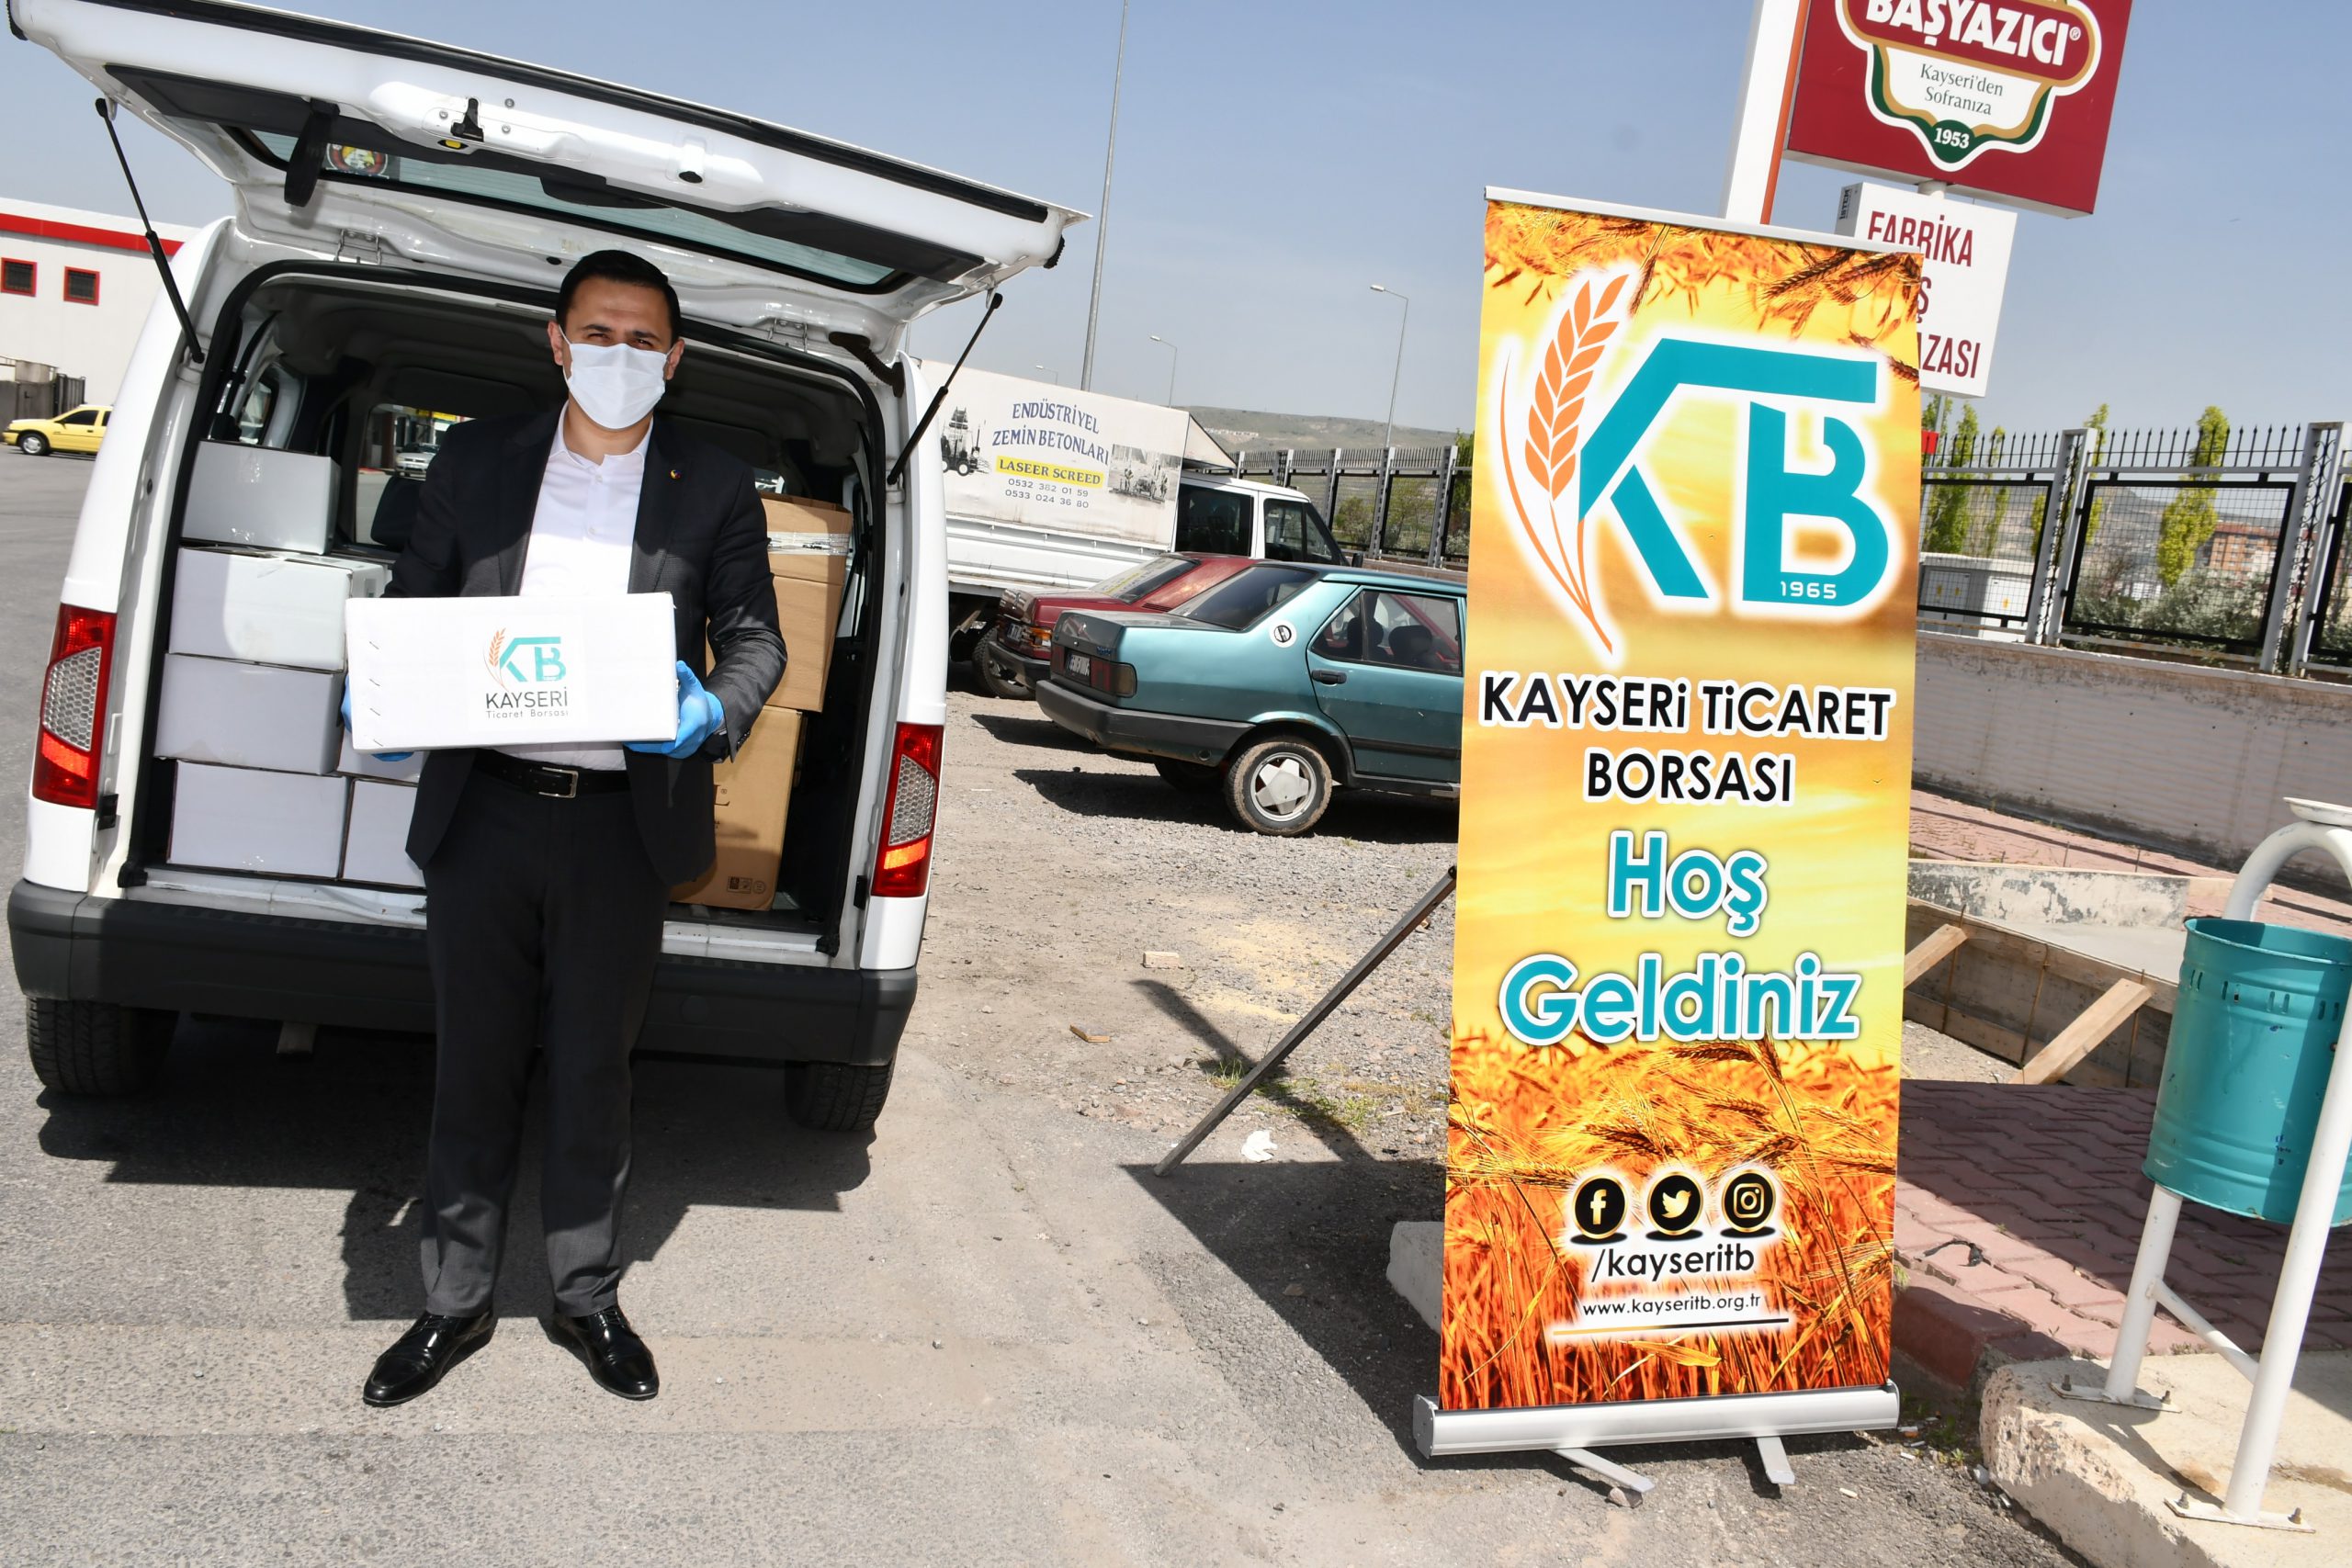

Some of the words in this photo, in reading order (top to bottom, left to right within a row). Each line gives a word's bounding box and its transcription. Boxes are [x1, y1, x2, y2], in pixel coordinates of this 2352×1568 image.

[1920, 62, 2004, 96] Kayseri'den
[1925, 86, 1992, 116] Sofranıza
[1933, 127, 1970, 150] 1953
[1012, 398, 1100, 434] ENDÜSTRİYEL
[992, 424, 1036, 446] ZEMİN
[1038, 429, 1109, 466] BETONLARI
[1000, 458, 1049, 477] LASEER
[1052, 468, 1101, 484] SCREED
[1005, 489, 1031, 500] 0533
[1035, 493, 1055, 502] 024
[1059, 497, 1072, 505] 36
[1076, 500, 1089, 508] 80
[1008, 478, 1034, 489] 0532
[1077, 489, 1089, 497] 59
[1780, 580, 1838, 600] 1965
[486, 686, 568, 709] KAYSERİ
[486, 710, 523, 718] Ticaret
[530, 708, 569, 717] Borsası
[1589, 752, 1791, 802] BORSASI
[1610, 833, 1766, 934] Hoş
[1502, 954, 1859, 1043] Geldiniz
[1591, 1243, 1755, 1282] /kayseritb
[1583, 1293, 1760, 1316] www.kayseritb.org.tr
